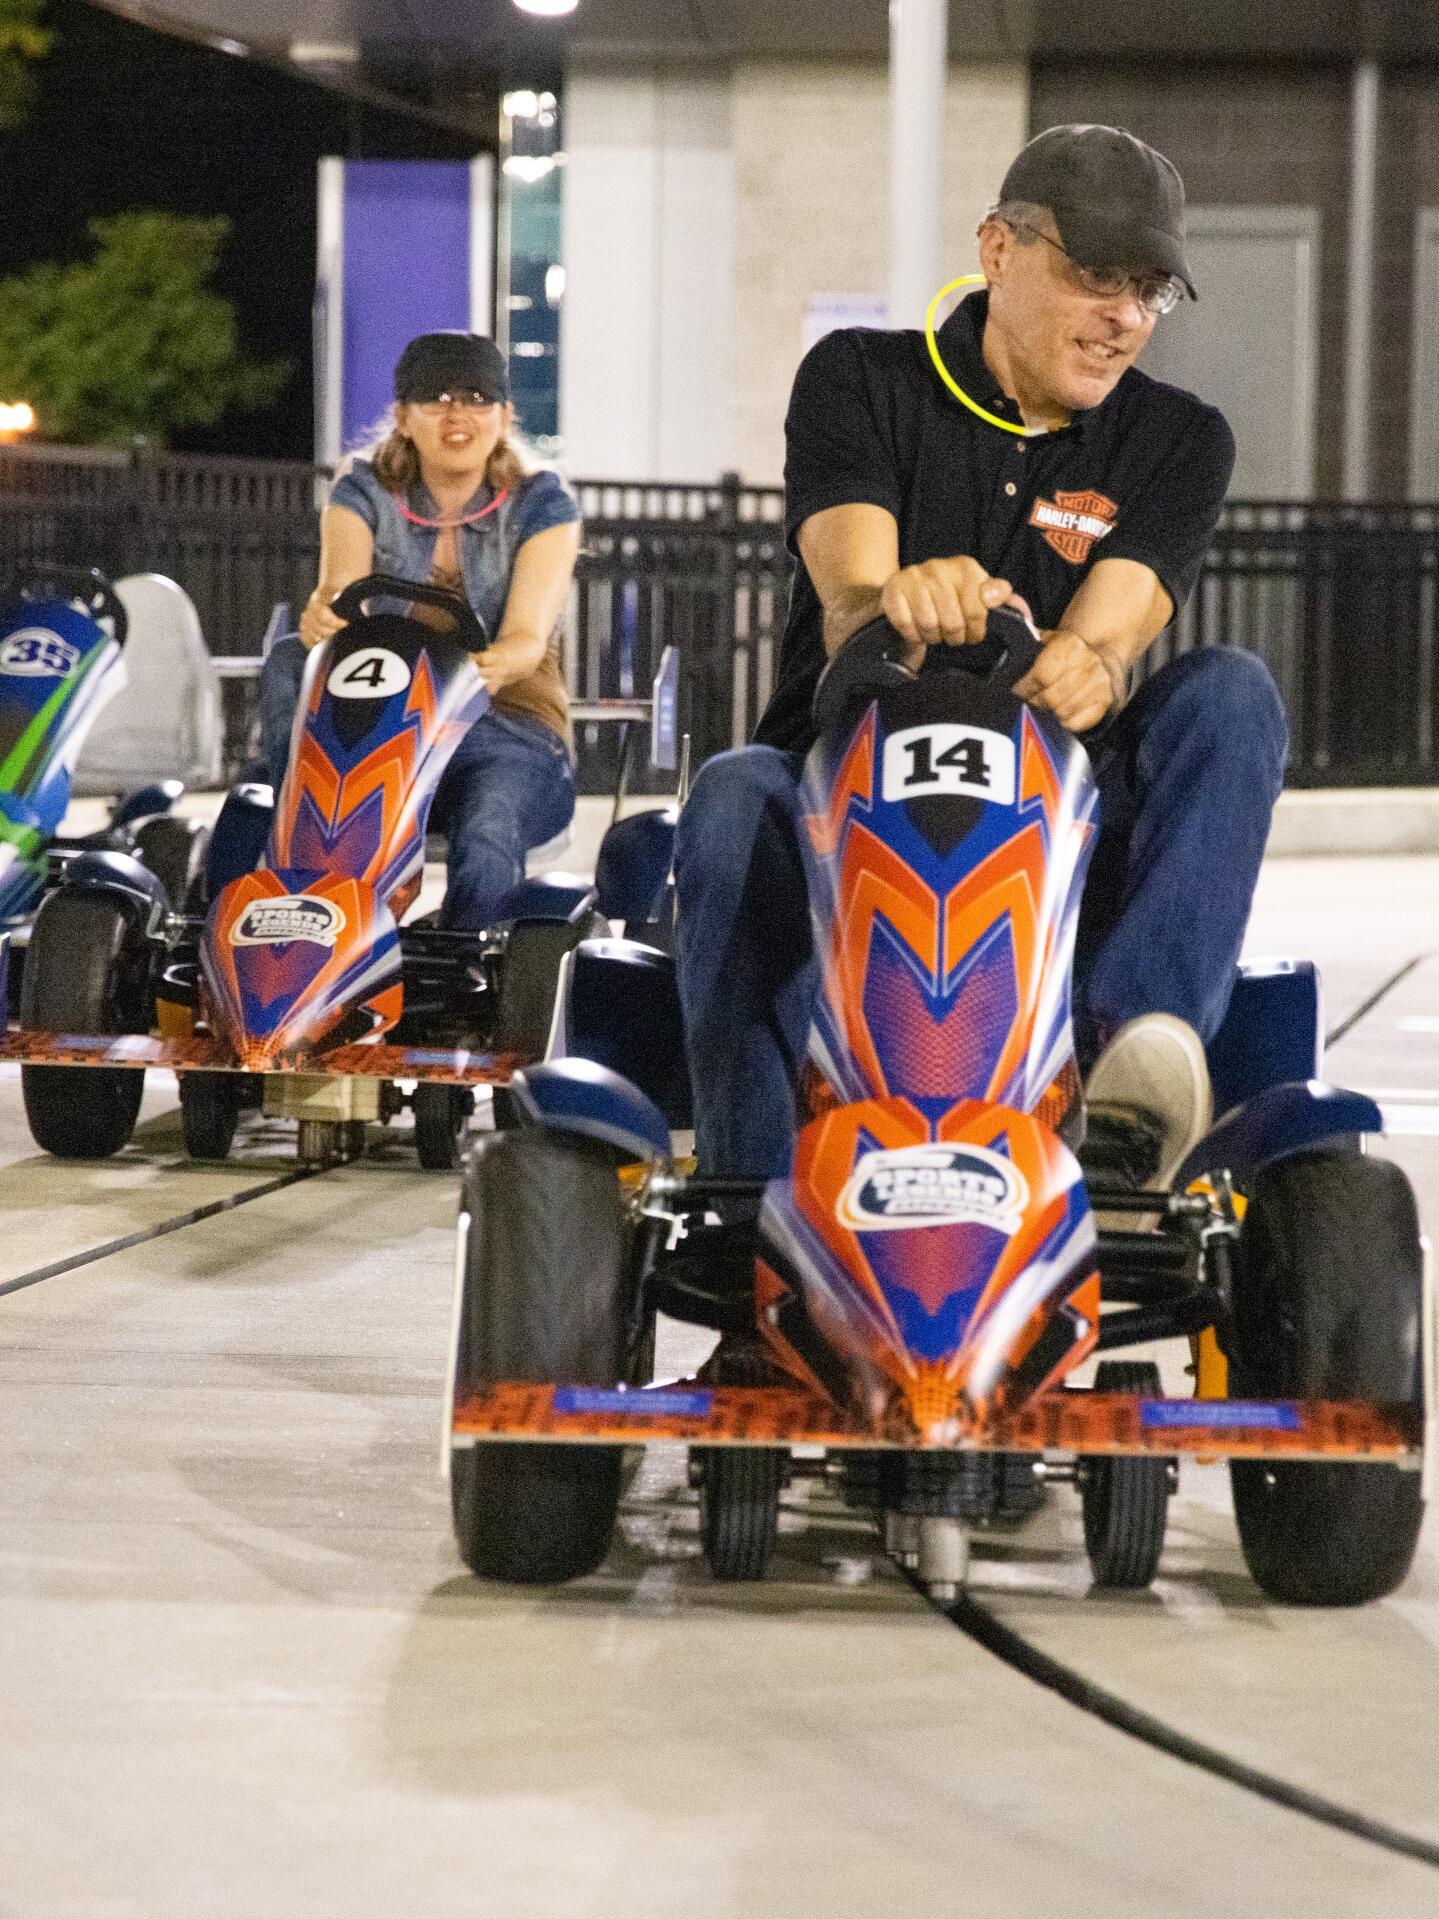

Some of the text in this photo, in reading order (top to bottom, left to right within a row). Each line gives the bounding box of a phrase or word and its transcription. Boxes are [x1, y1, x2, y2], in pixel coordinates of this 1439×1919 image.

[9, 639, 71, 672] 35
[343, 657, 386, 687] 4
[903, 736, 990, 788] 14
